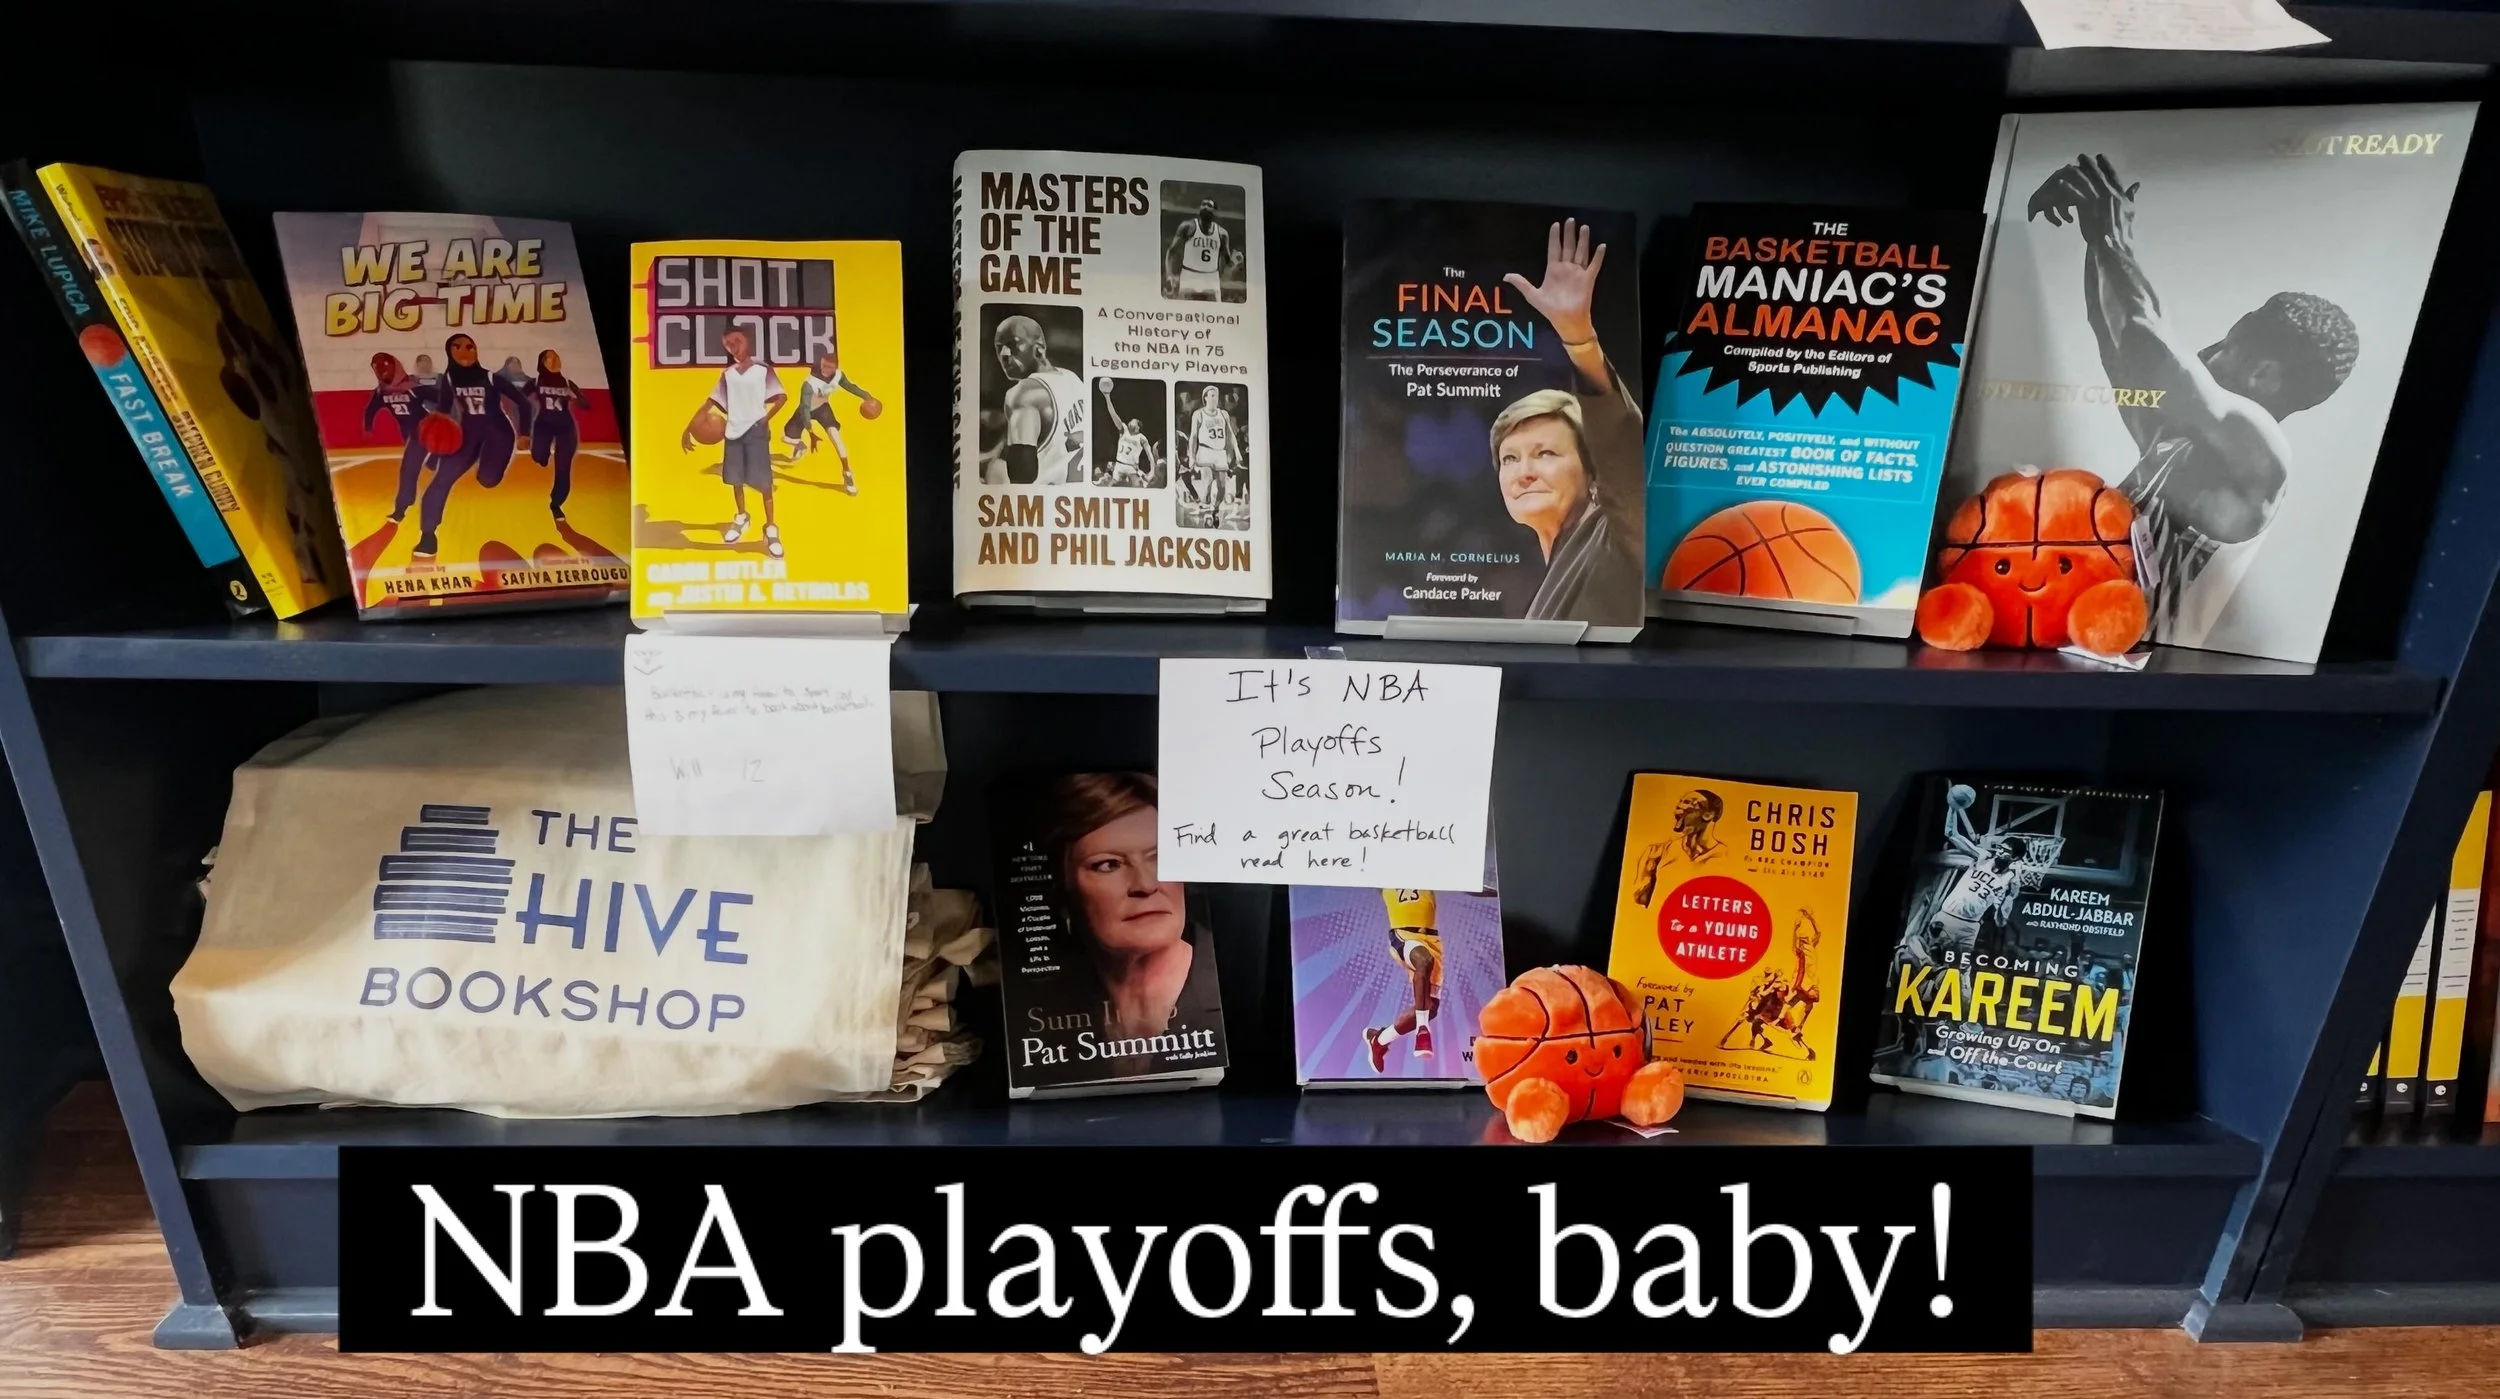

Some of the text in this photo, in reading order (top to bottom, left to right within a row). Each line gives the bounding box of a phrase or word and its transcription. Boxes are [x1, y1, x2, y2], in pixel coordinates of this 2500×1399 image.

[2343, 133, 2443, 156] READY
[981, 172, 1149, 215] MASTERS
[980, 213, 1101, 255] OF THE
[1813, 222, 1848, 237] THE
[8, 188, 51, 241] MIKE
[40, 244, 92, 318] LUPICA
[340, 236, 545, 286] WE ARE
[1201, 249, 1212, 263] 6
[1705, 236, 1951, 270] BASKETBALL
[657, 257, 797, 308] SHOT
[980, 254, 1082, 296] GAME
[1443, 266, 1465, 278] The
[1398, 283, 1513, 315] FINAL
[1696, 265, 1947, 308] MANIAC'S
[325, 282, 567, 336] BIG TIME
[1098, 308, 1240, 325] A Conversational
[1128, 325, 1212, 341] History of
[1372, 318, 1534, 349] SEASON
[1687, 302, 1941, 346] ALMANAC
[657, 314, 836, 365] CLOCK
[1114, 341, 1141, 353] the
[1146, 342, 1181, 355] NBA
[1204, 345, 1225, 357] 75
[1091, 356, 1248, 376] Legendary Players
[1723, 345, 1893, 363] Compiled by the Editors of
[1389, 363, 1519, 379] The Perseverance of
[1748, 360, 1861, 379] Sports Publishing
[1406, 383, 1501, 398] Pat Summitt
[2083, 385, 2166, 409] CURRY
[108, 371, 195, 500] FAST BREAK
[1690, 427, 1765, 442] ABSOLUTELY,
[1768, 431, 1836, 446] POSITIVELY,
[1666, 442, 1920, 467] QUESTION GREATEST BOOK OF FACTS,
[1664, 456, 1730, 471] FIGURES,
[1756, 460, 1864, 479] ASTONISHING
[1868, 468, 1913, 483] LISTS
[1735, 475, 1830, 491] EVER COMPILED
[978, 494, 1044, 528] SAM
[1055, 496, 1150, 530] SMITH
[978, 532, 1251, 572] AND PHIL JACKSON
[1385, 552, 1426, 562] MARIA
[1449, 553, 1520, 563] CORNELIUS
[384, 575, 473, 594] HENA KHAN
[502, 570, 552, 586] SAFIYA
[1426, 572, 1479, 584] Foreword by
[1403, 586, 1502, 602] Candace Parker
[1226, 667, 1429, 703] It's NBA
[1252, 723, 1382, 767] Playoffs
[669, 757, 703, 781] Will
[1262, 756, 1406, 803] Season!
[1746, 800, 1836, 829] CHRIS
[531, 809, 638, 853] THE
[1172, 820, 1456, 850] Find a great basketball
[1750, 828, 1829, 856] BOSH
[1240, 847, 1367, 872] read here!
[1968, 880, 1991, 900] 33
[2050, 887, 2110, 906] KAREEM
[1681, 893, 1753, 915] LETTERS
[2022, 903, 2134, 926] ABDUL-JABBAR
[515, 872, 754, 965] HIVE
[1705, 920, 1758, 940] YOUNG
[1675, 943, 1748, 963] ATHLETE
[1944, 950, 2079, 979] BECOMING
[359, 966, 745, 1033] BOOKSHOP
[1683, 983, 1695, 997] by
[1894, 963, 2119, 1042] KAREEM
[1644, 995, 1685, 1013] PAT
[1027, 1005, 1093, 1034] Sum
[1021, 1024, 1216, 1067] Pat Summitt
[1935, 1025, 2061, 1054] Growing Up On
[1950, 1047, 1981, 1063] Off
[1981, 1050, 2009, 1067] the
[2013, 1056, 2063, 1074] Court
